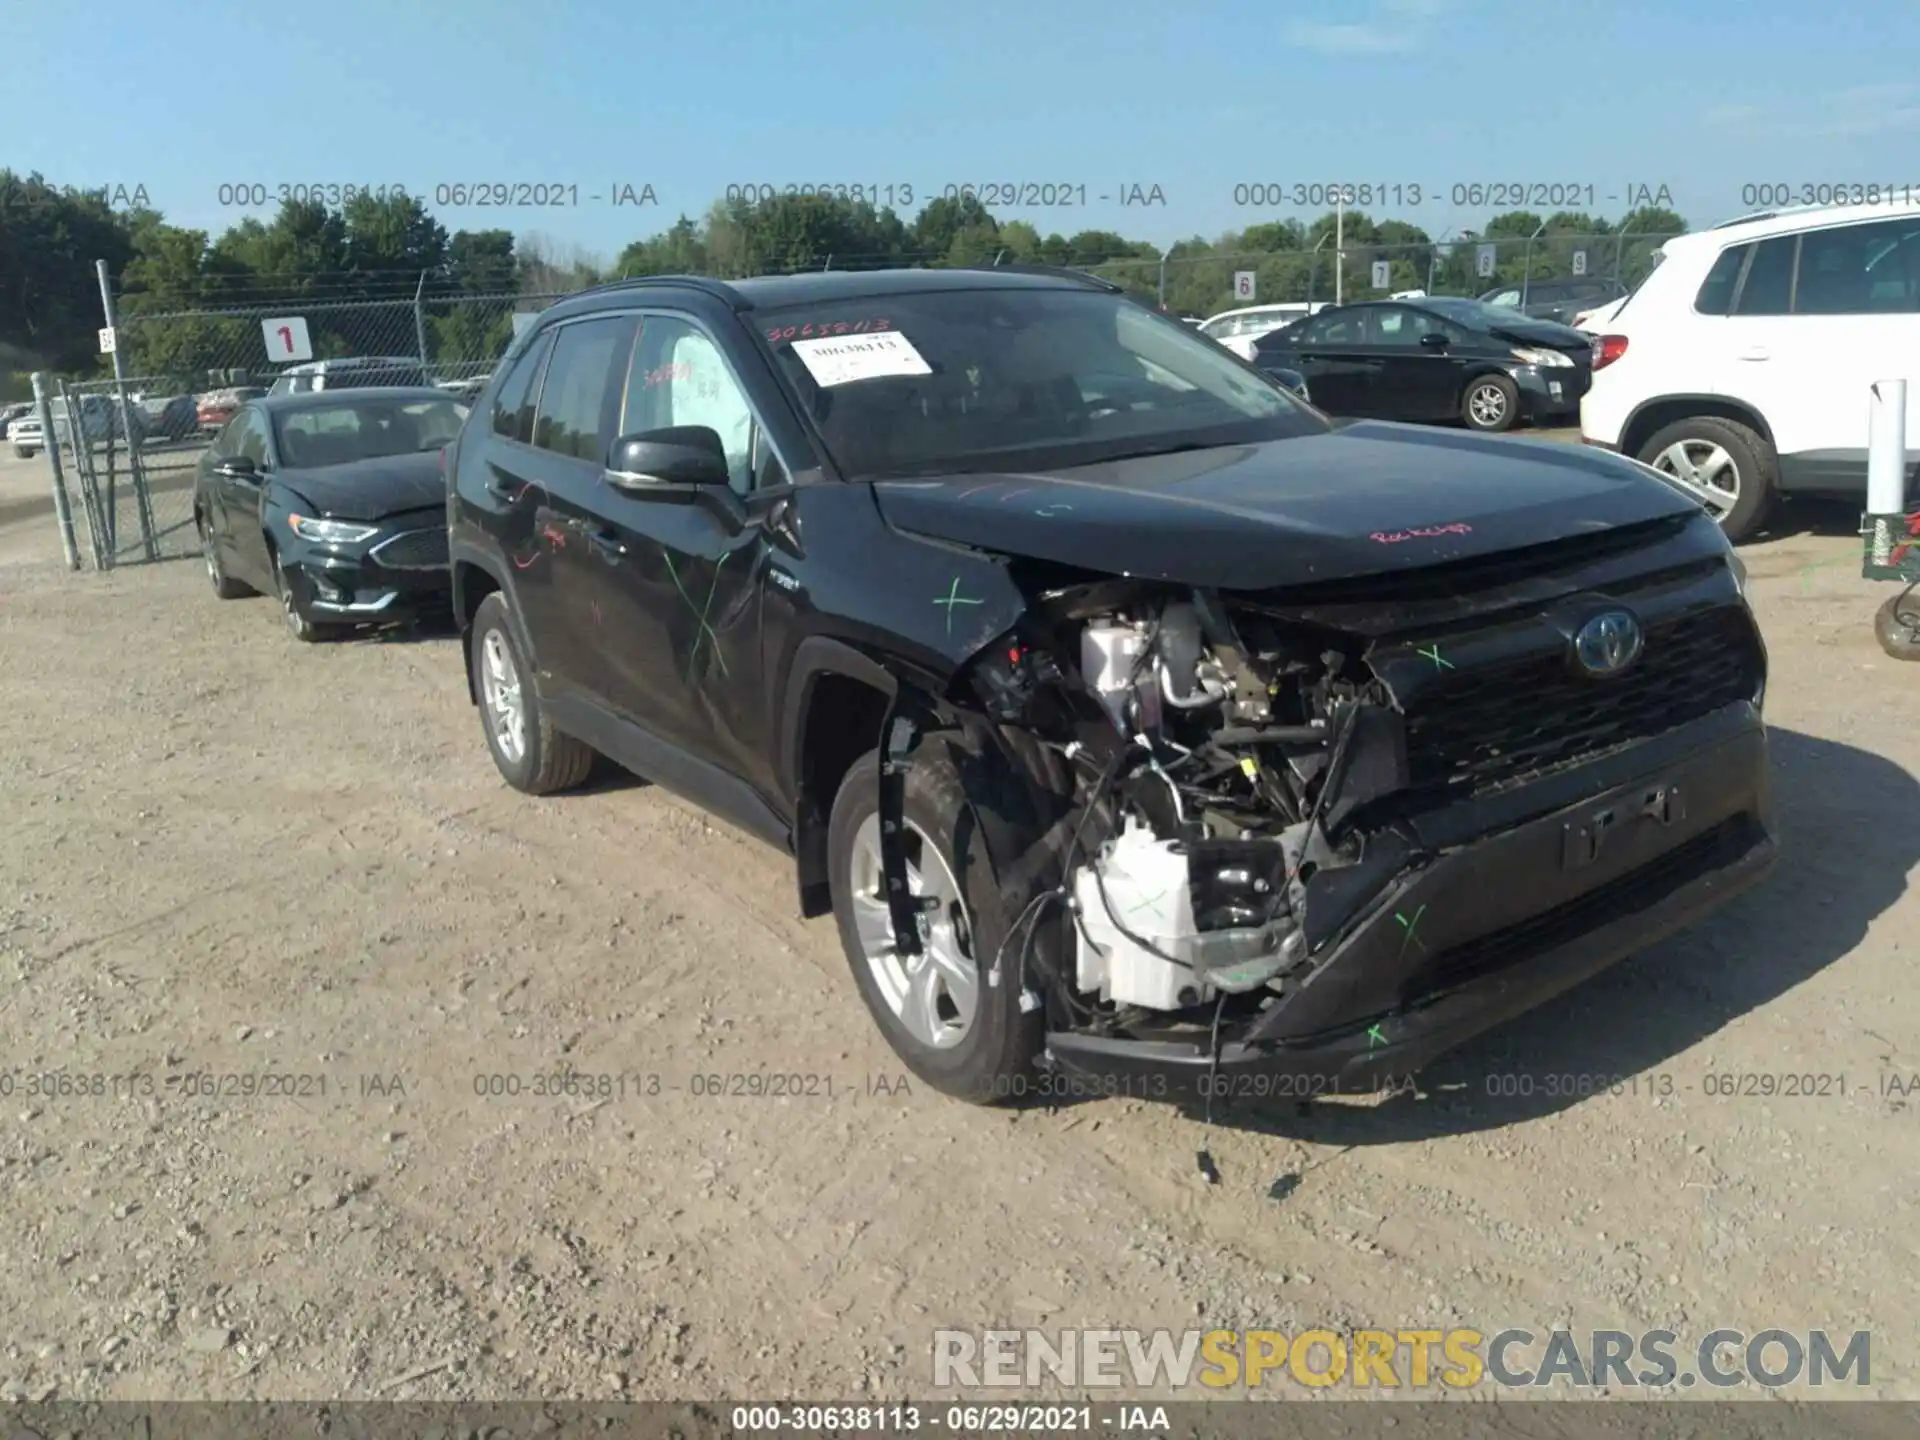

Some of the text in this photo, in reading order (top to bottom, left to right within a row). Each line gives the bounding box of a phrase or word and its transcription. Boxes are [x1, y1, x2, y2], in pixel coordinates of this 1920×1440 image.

[1377, 266, 1384, 285] 7
[1240, 276, 1249, 295] 6
[277, 326, 294, 353] 1
